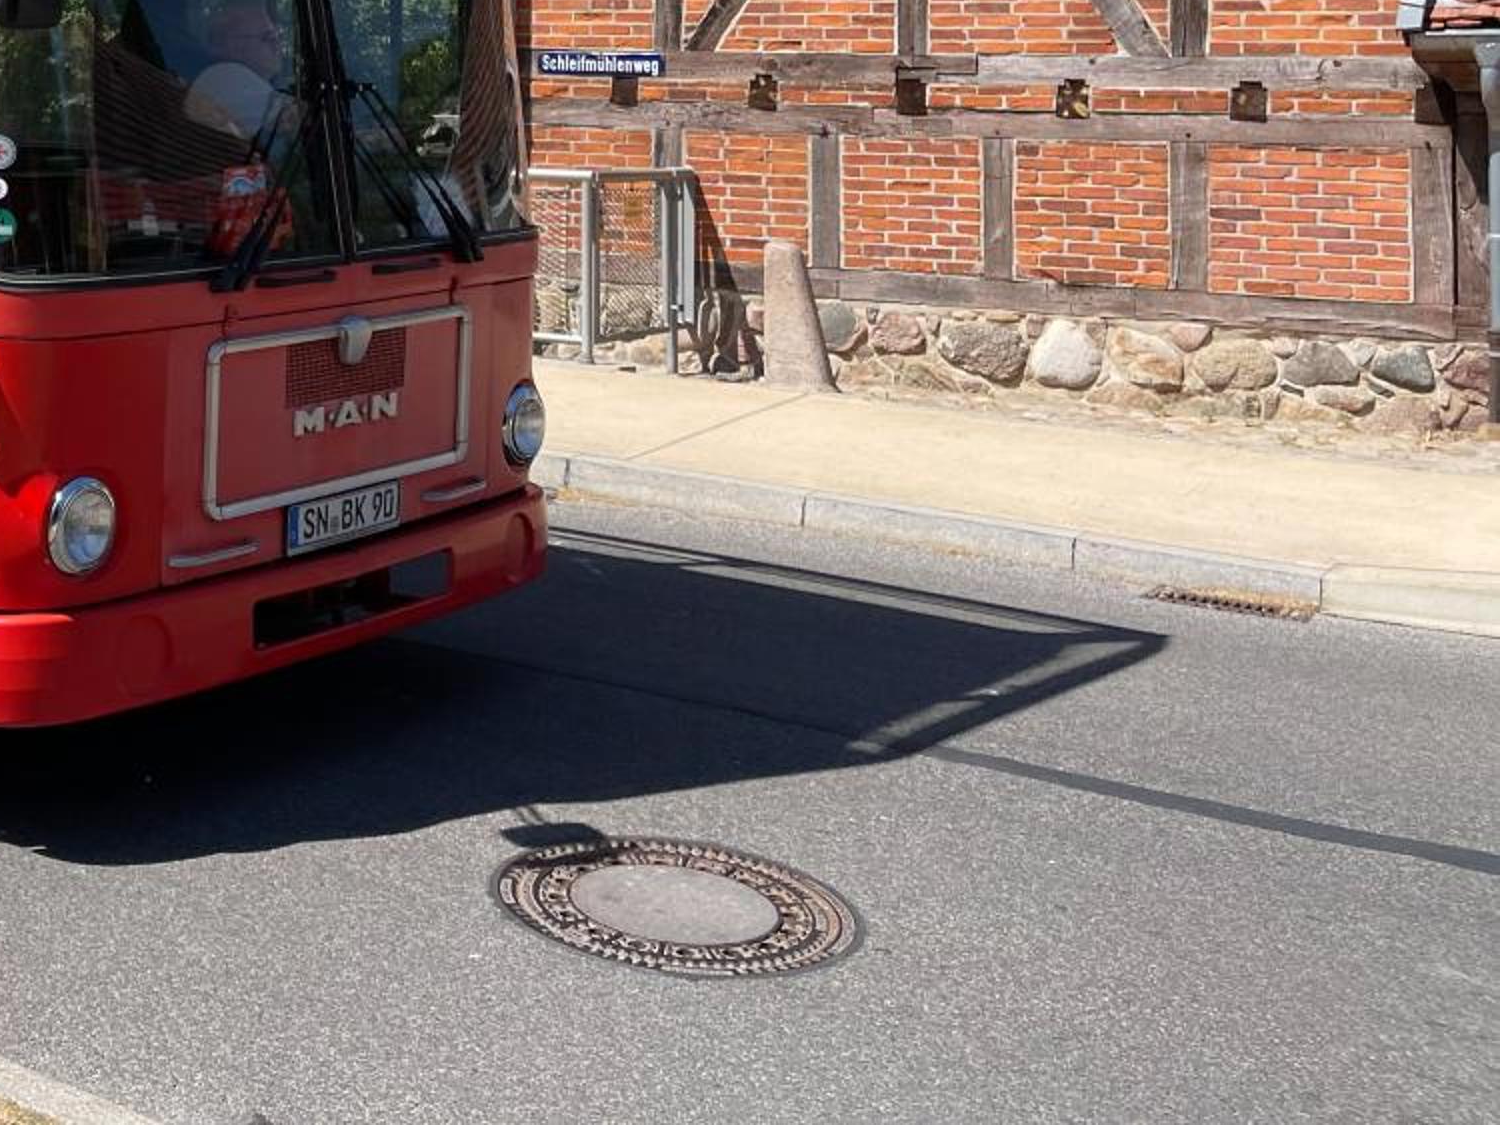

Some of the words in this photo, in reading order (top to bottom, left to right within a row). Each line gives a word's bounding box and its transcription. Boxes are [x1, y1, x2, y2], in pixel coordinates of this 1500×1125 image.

[541, 54, 660, 76] Schleifmühlenweg
[303, 505, 329, 539] SN
[341, 495, 367, 530] BK
[372, 488, 395, 521] 90
